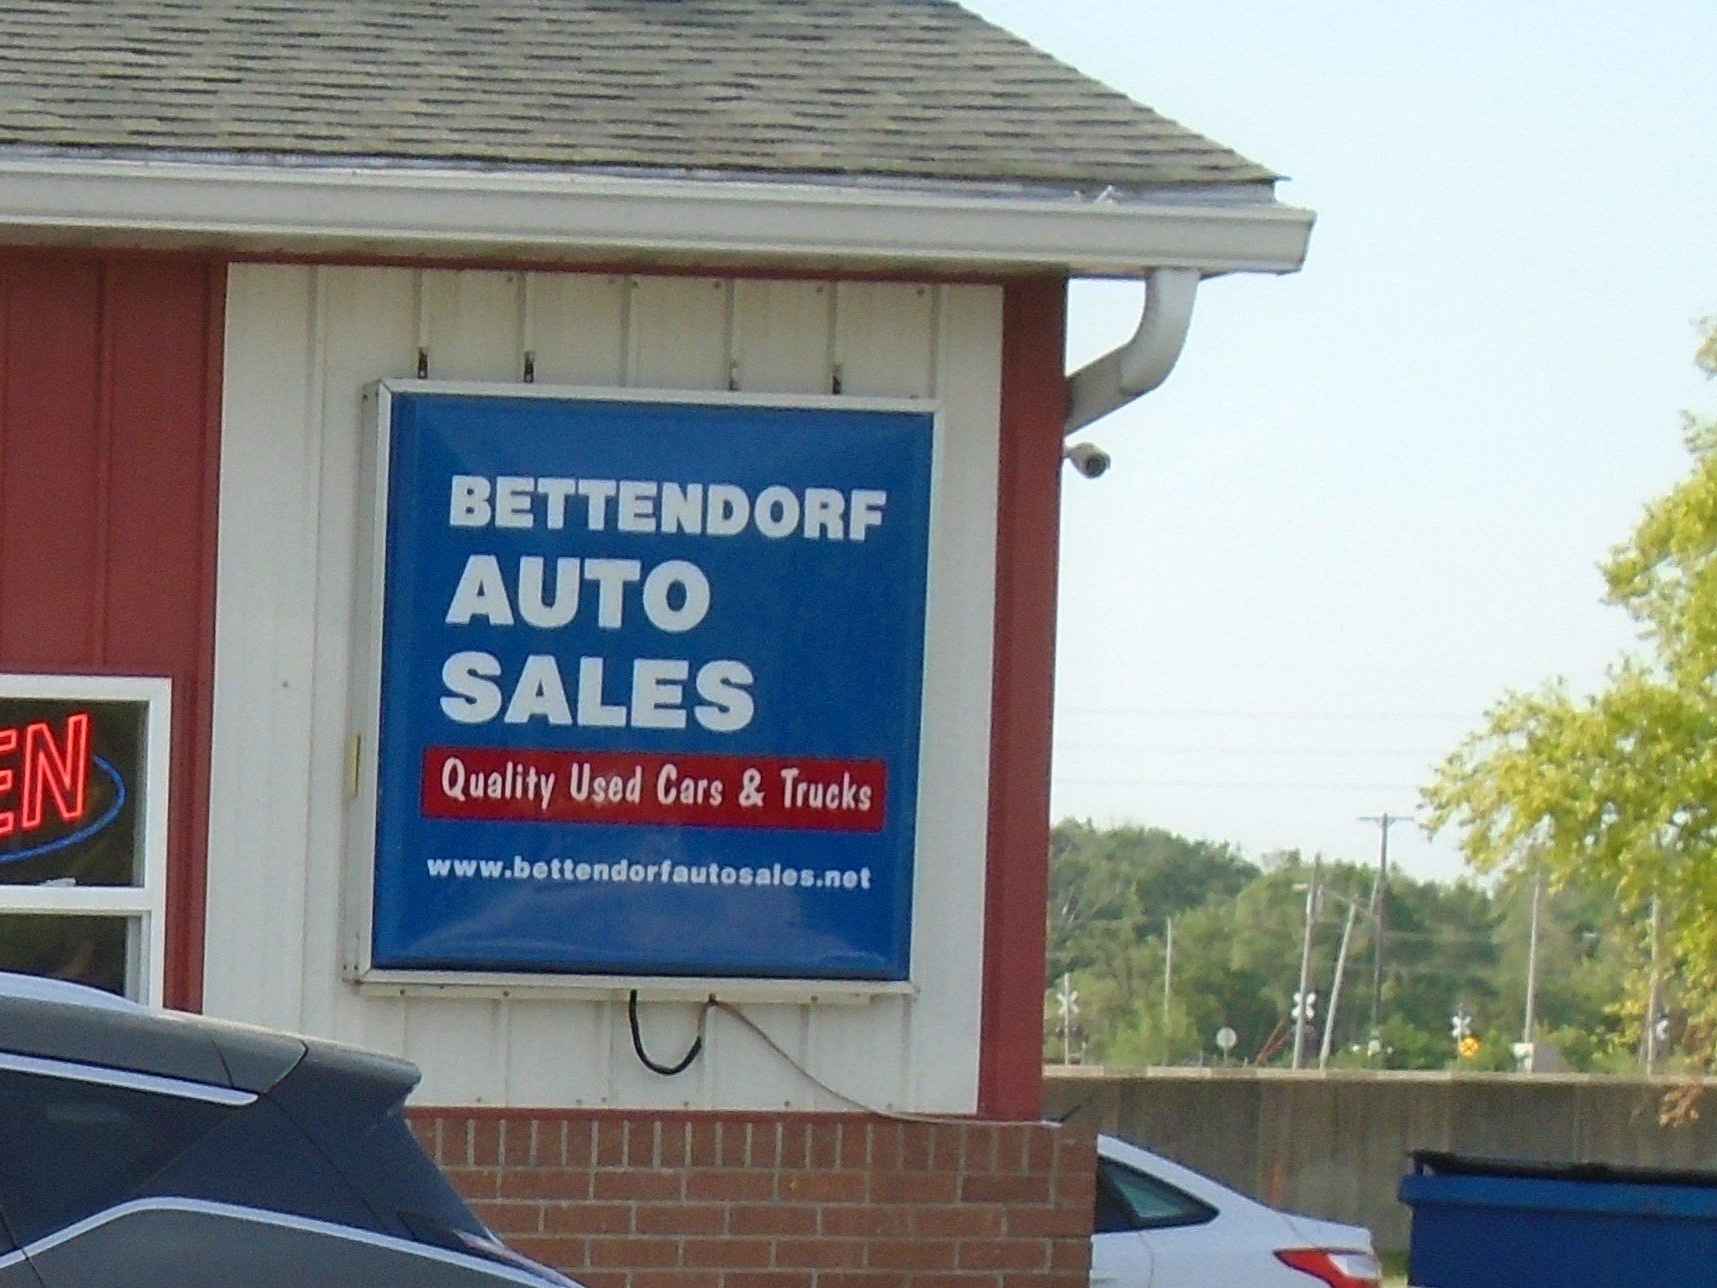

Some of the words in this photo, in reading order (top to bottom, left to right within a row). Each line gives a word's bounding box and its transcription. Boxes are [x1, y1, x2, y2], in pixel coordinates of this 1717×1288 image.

[449, 475, 888, 541] BETTENDORF
[445, 554, 712, 633] AUTO
[439, 651, 756, 733] SALES
[441, 757, 556, 811] Quality
[569, 762, 643, 805] Used
[656, 763, 724, 807] Cars
[738, 767, 765, 808] &
[780, 767, 873, 813] Trucks
[426, 854, 872, 890] www.bettendorfautosales.net
